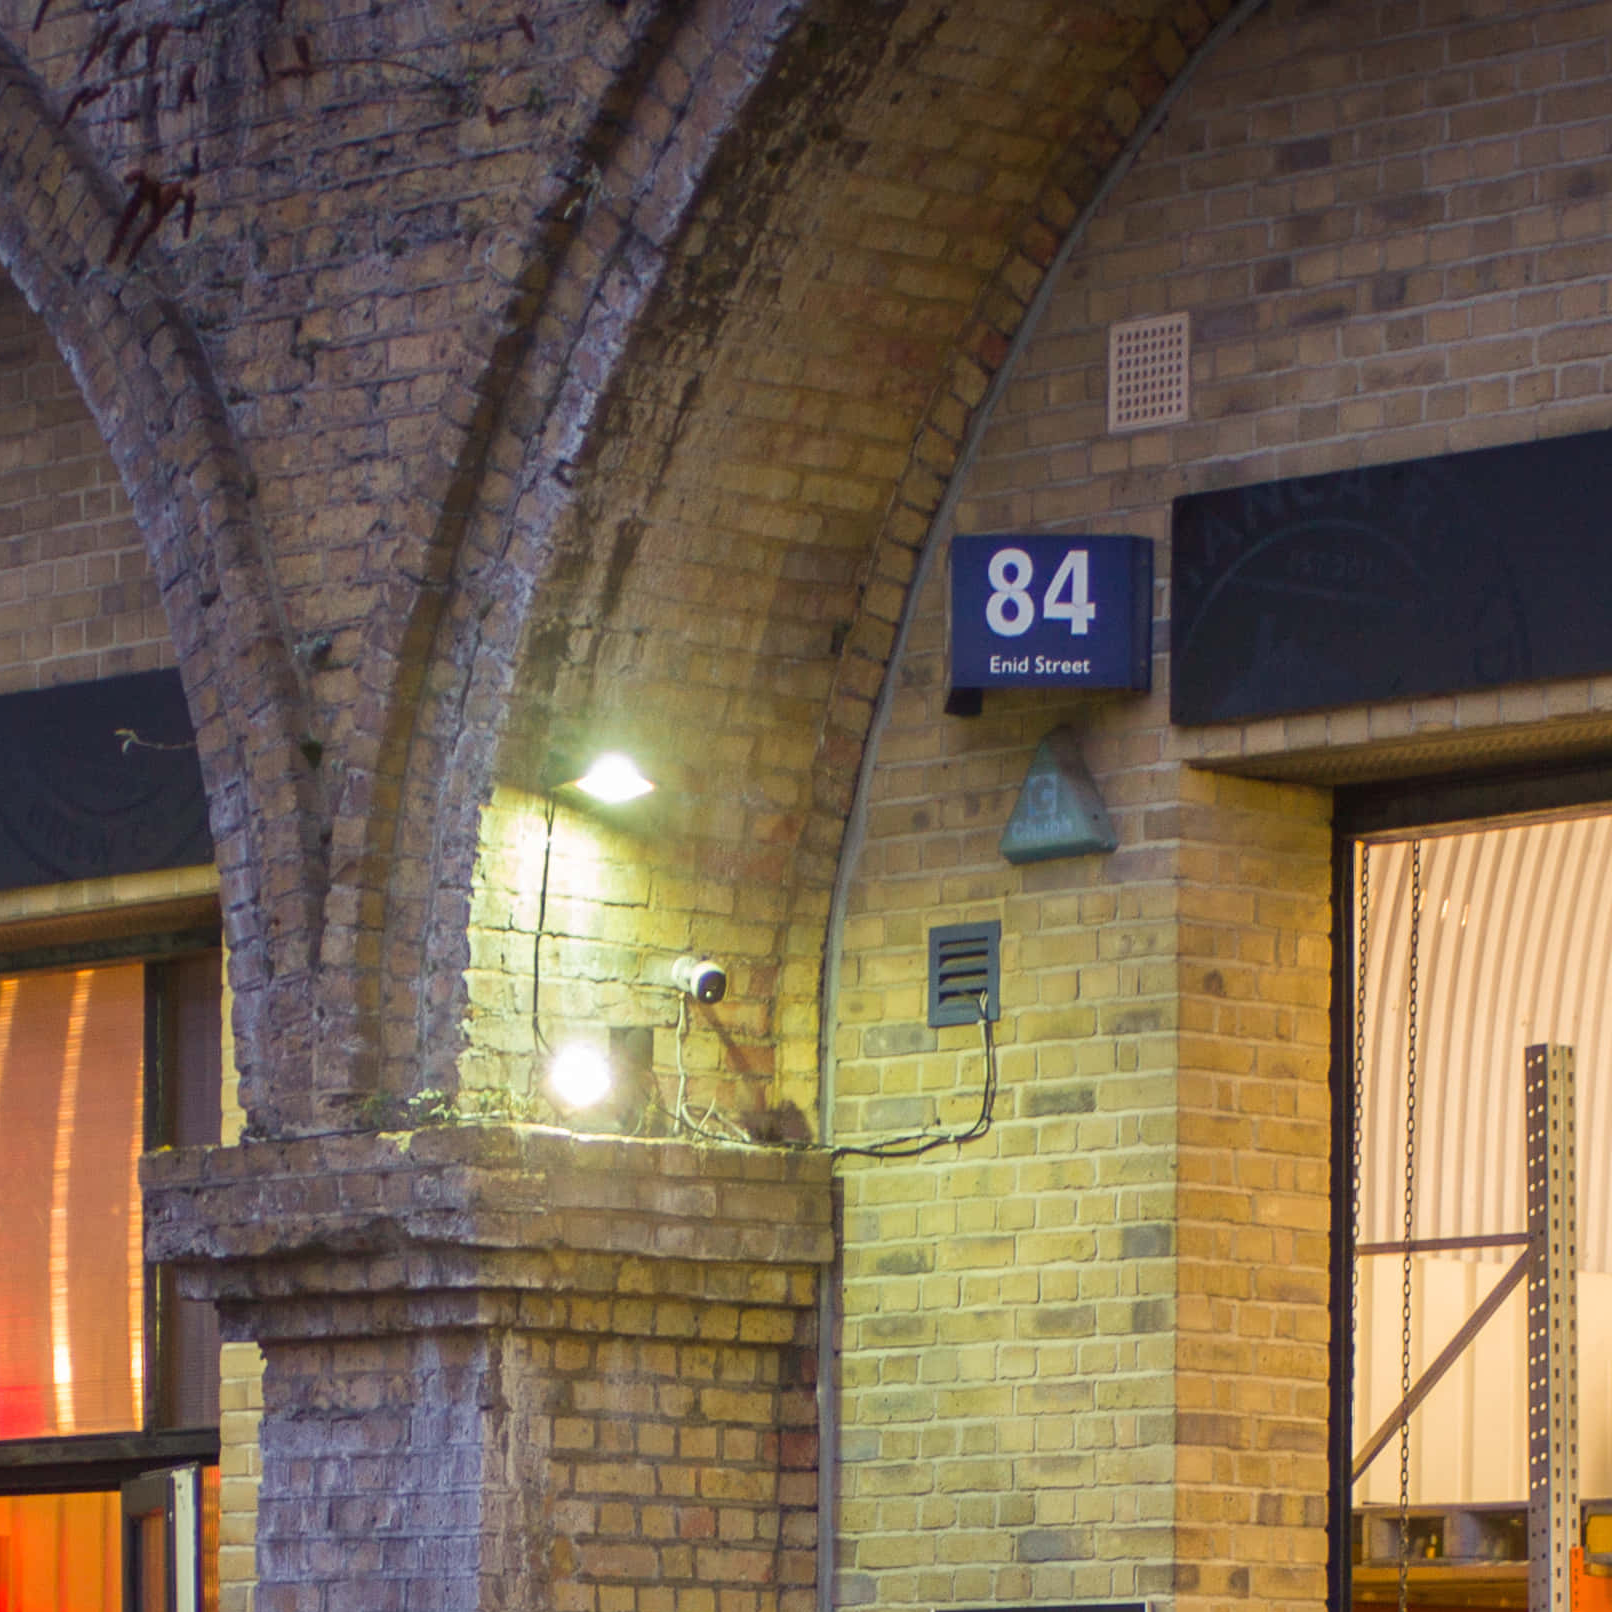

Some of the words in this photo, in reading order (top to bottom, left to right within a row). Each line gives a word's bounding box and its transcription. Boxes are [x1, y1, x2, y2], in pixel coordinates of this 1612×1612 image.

[986, 548, 1096, 637] 84
[989, 655, 1029, 675] Enid
[1034, 655, 1091, 675] Street
